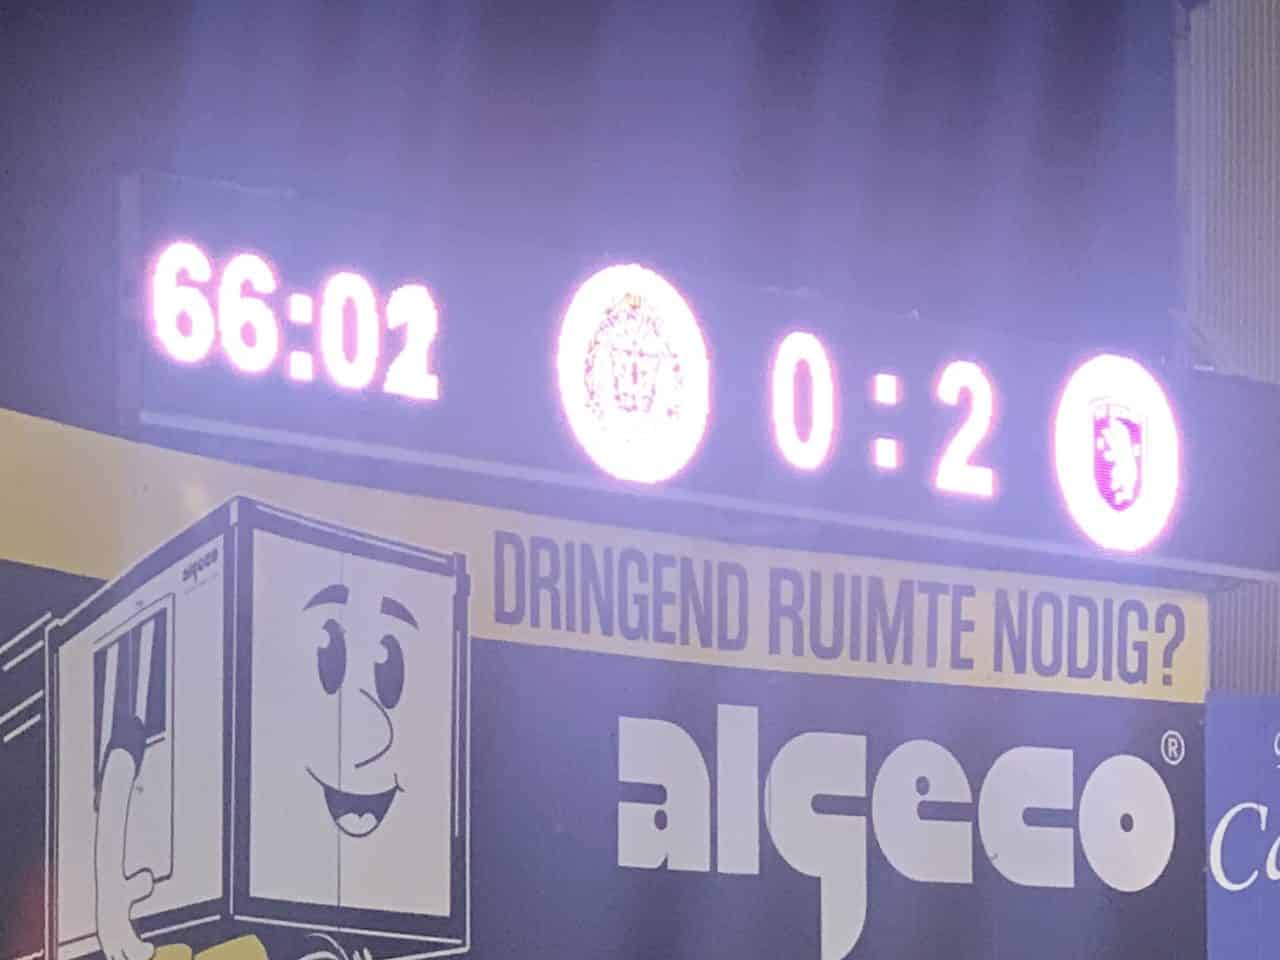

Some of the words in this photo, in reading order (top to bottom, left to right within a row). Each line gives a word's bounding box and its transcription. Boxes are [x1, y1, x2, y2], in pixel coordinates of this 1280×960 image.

[152, 240, 440, 401] 66:02
[772, 331, 835, 470] 0
[935, 360, 994, 498] 2
[493, 529, 750, 652] DRINGEND
[767, 567, 977, 671] RUIMTE
[992, 588, 1187, 687] NODIG?
